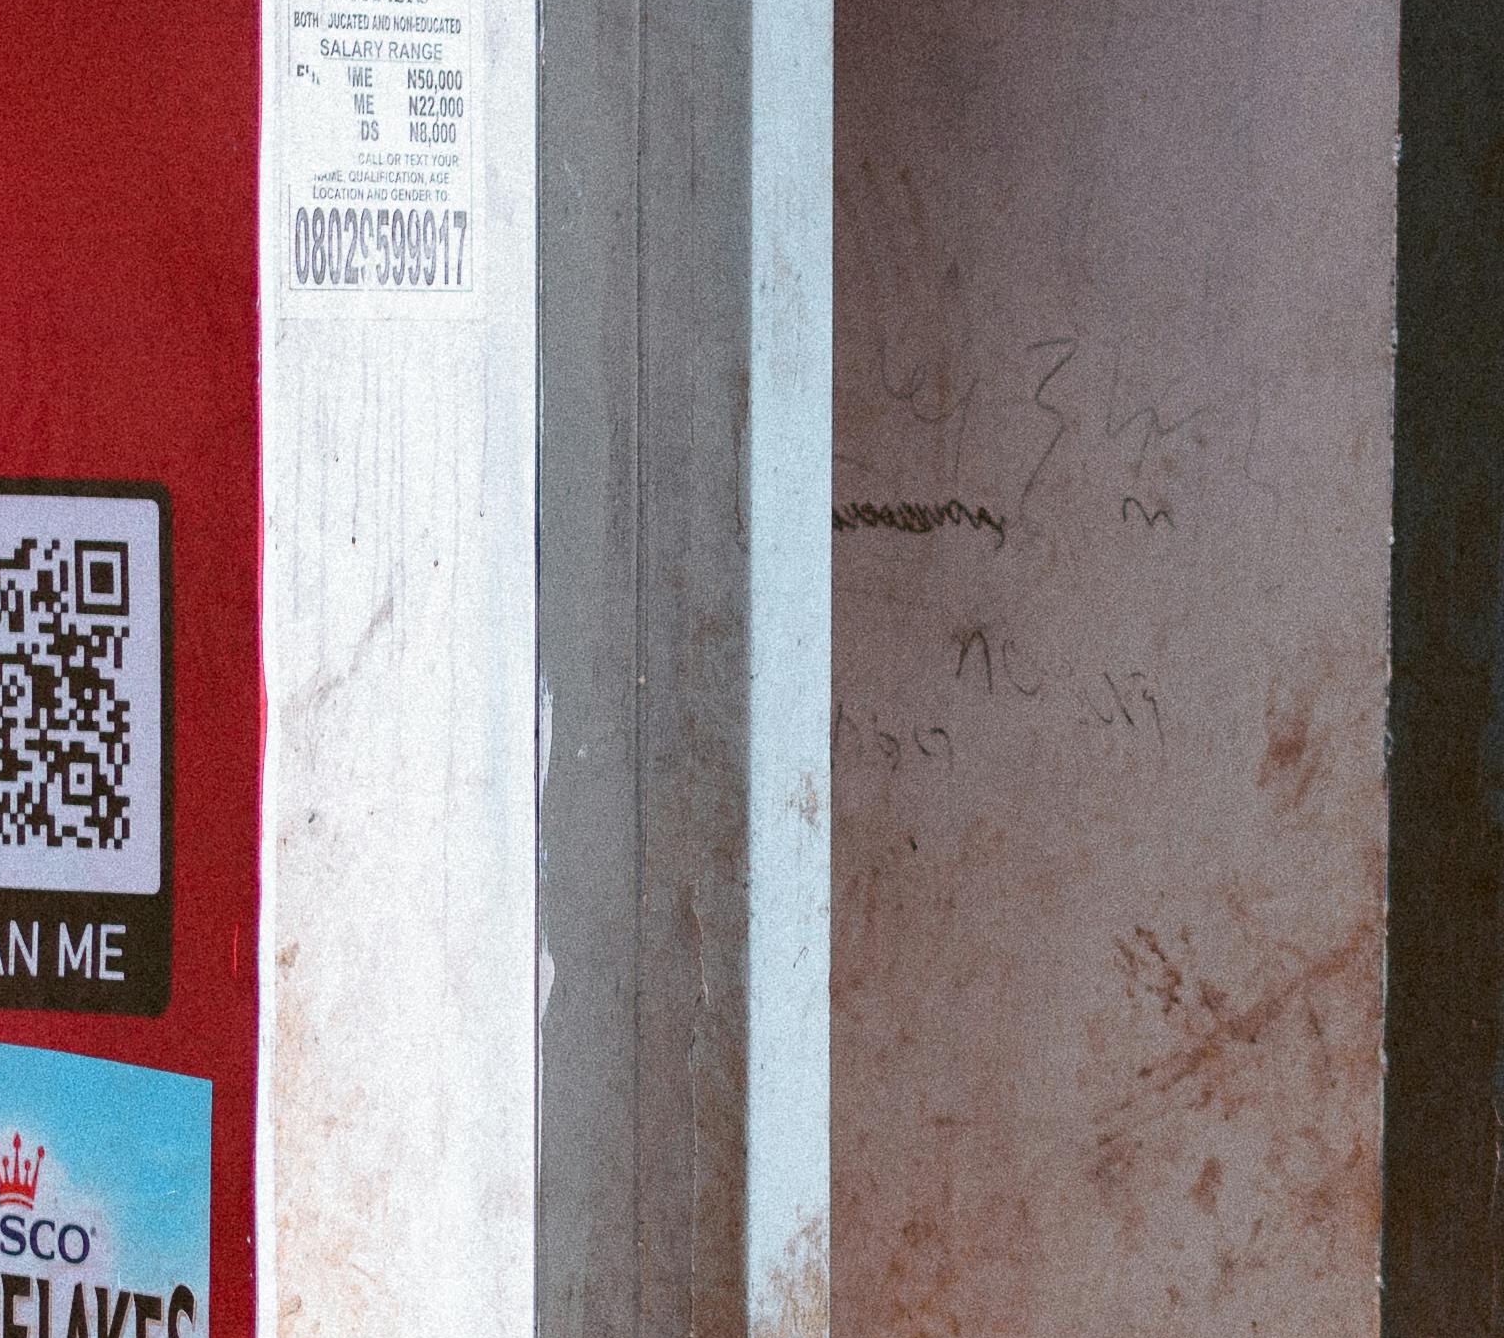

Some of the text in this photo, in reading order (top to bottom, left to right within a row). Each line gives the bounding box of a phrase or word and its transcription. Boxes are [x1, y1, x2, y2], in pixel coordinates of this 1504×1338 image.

[294, 11, 461, 35] BOTH DUCATED AND NON-EDUCATED
[320, 38, 443, 61] SALARY RANGE
[348, 66, 373, 88] IME
[407, 68, 462, 95] N50,000
[409, 95, 464, 121] N22,000
[410, 121, 456, 147] N8,000
[358, 153, 459, 167] CALL OR TEXT YOUR
[429, 172, 449, 184] AGE
[313, 185, 364, 200] LOCATION
[367, 188, 387, 201] AND
[391, 188, 432, 202] GENDER
[58, 922, 126, 981] ME
